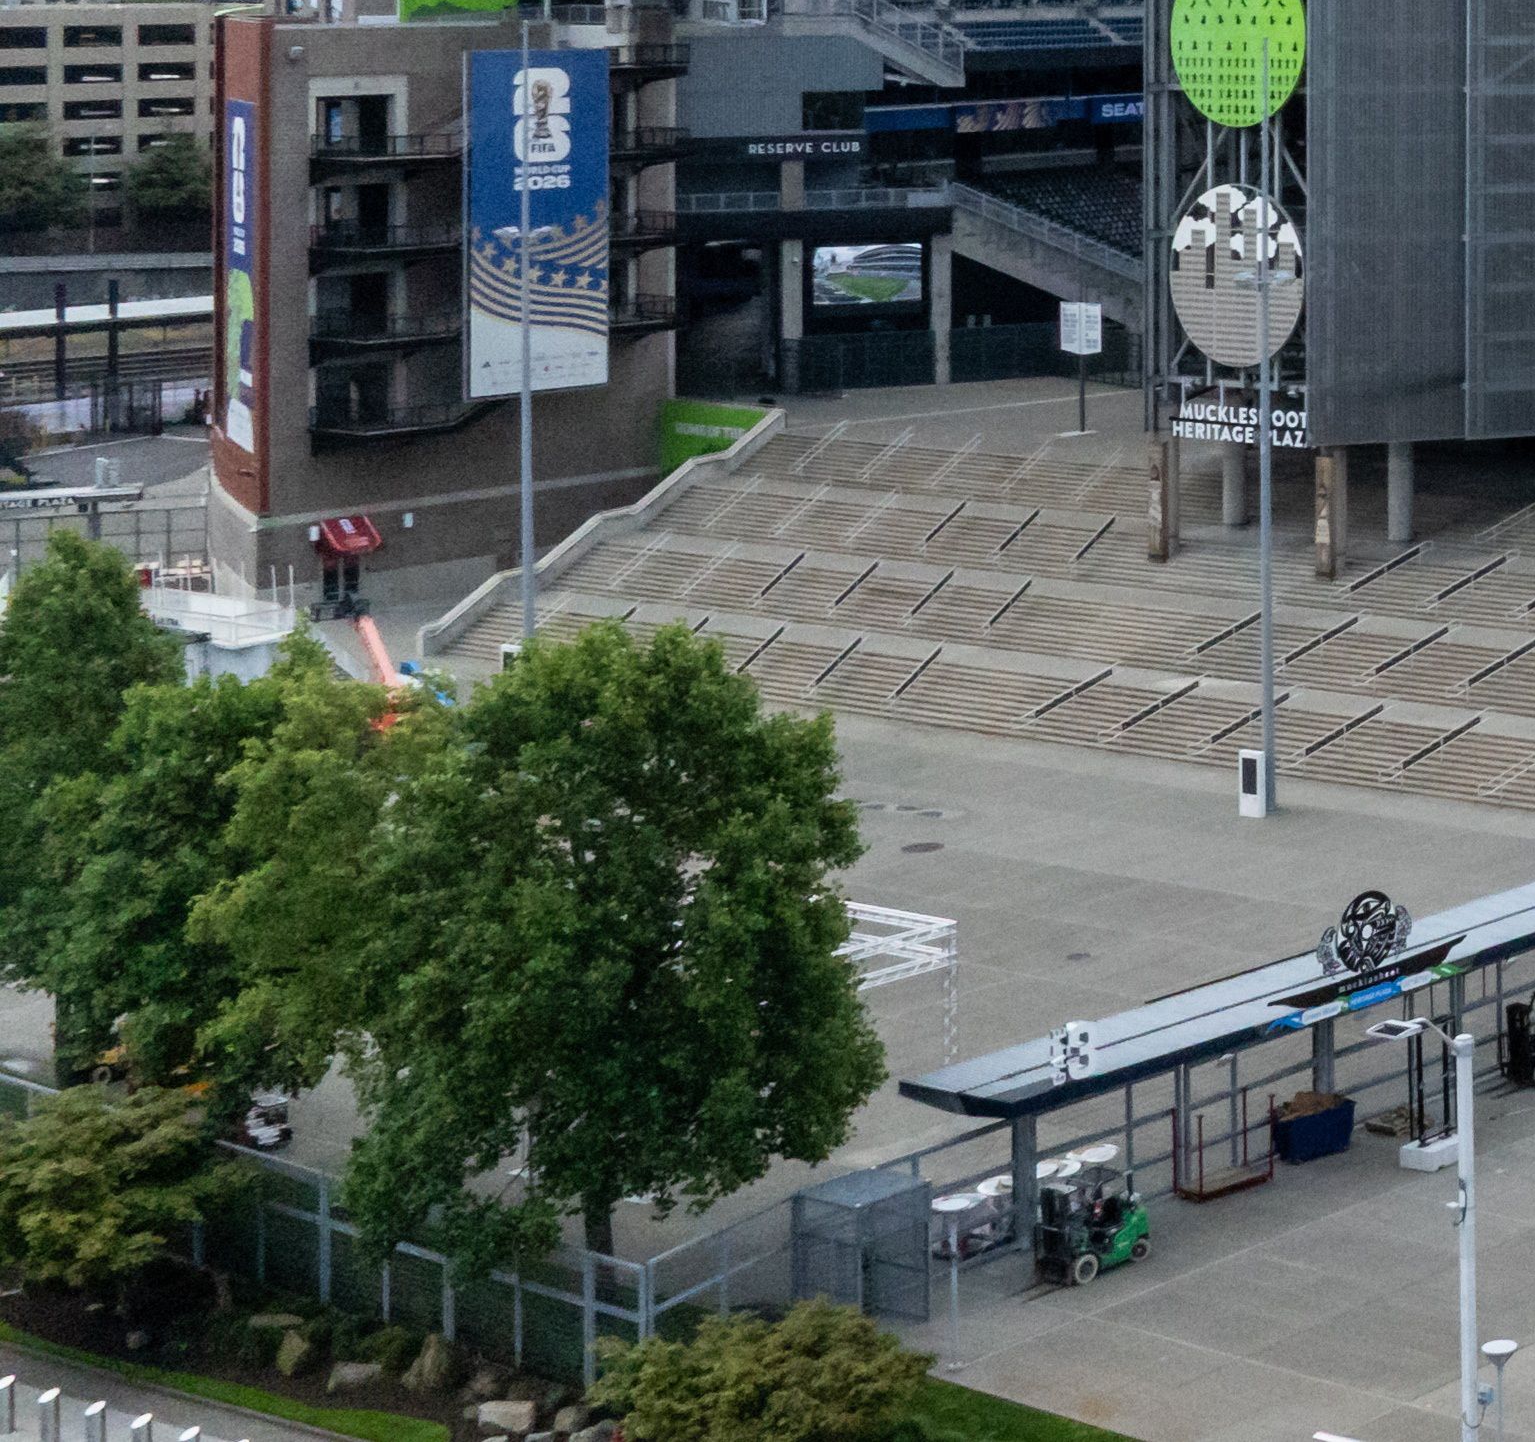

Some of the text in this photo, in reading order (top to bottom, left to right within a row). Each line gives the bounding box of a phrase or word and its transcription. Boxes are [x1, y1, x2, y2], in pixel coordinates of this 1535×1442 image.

[531, 143, 556, 153] FIFA
[748, 141, 861, 154] RESERVE CLUB
[513, 174, 571, 191] 2026
[1179, 403, 1307, 429] MUCKLESOOT
[1172, 420, 1308, 448] HERITAGE LAZ
